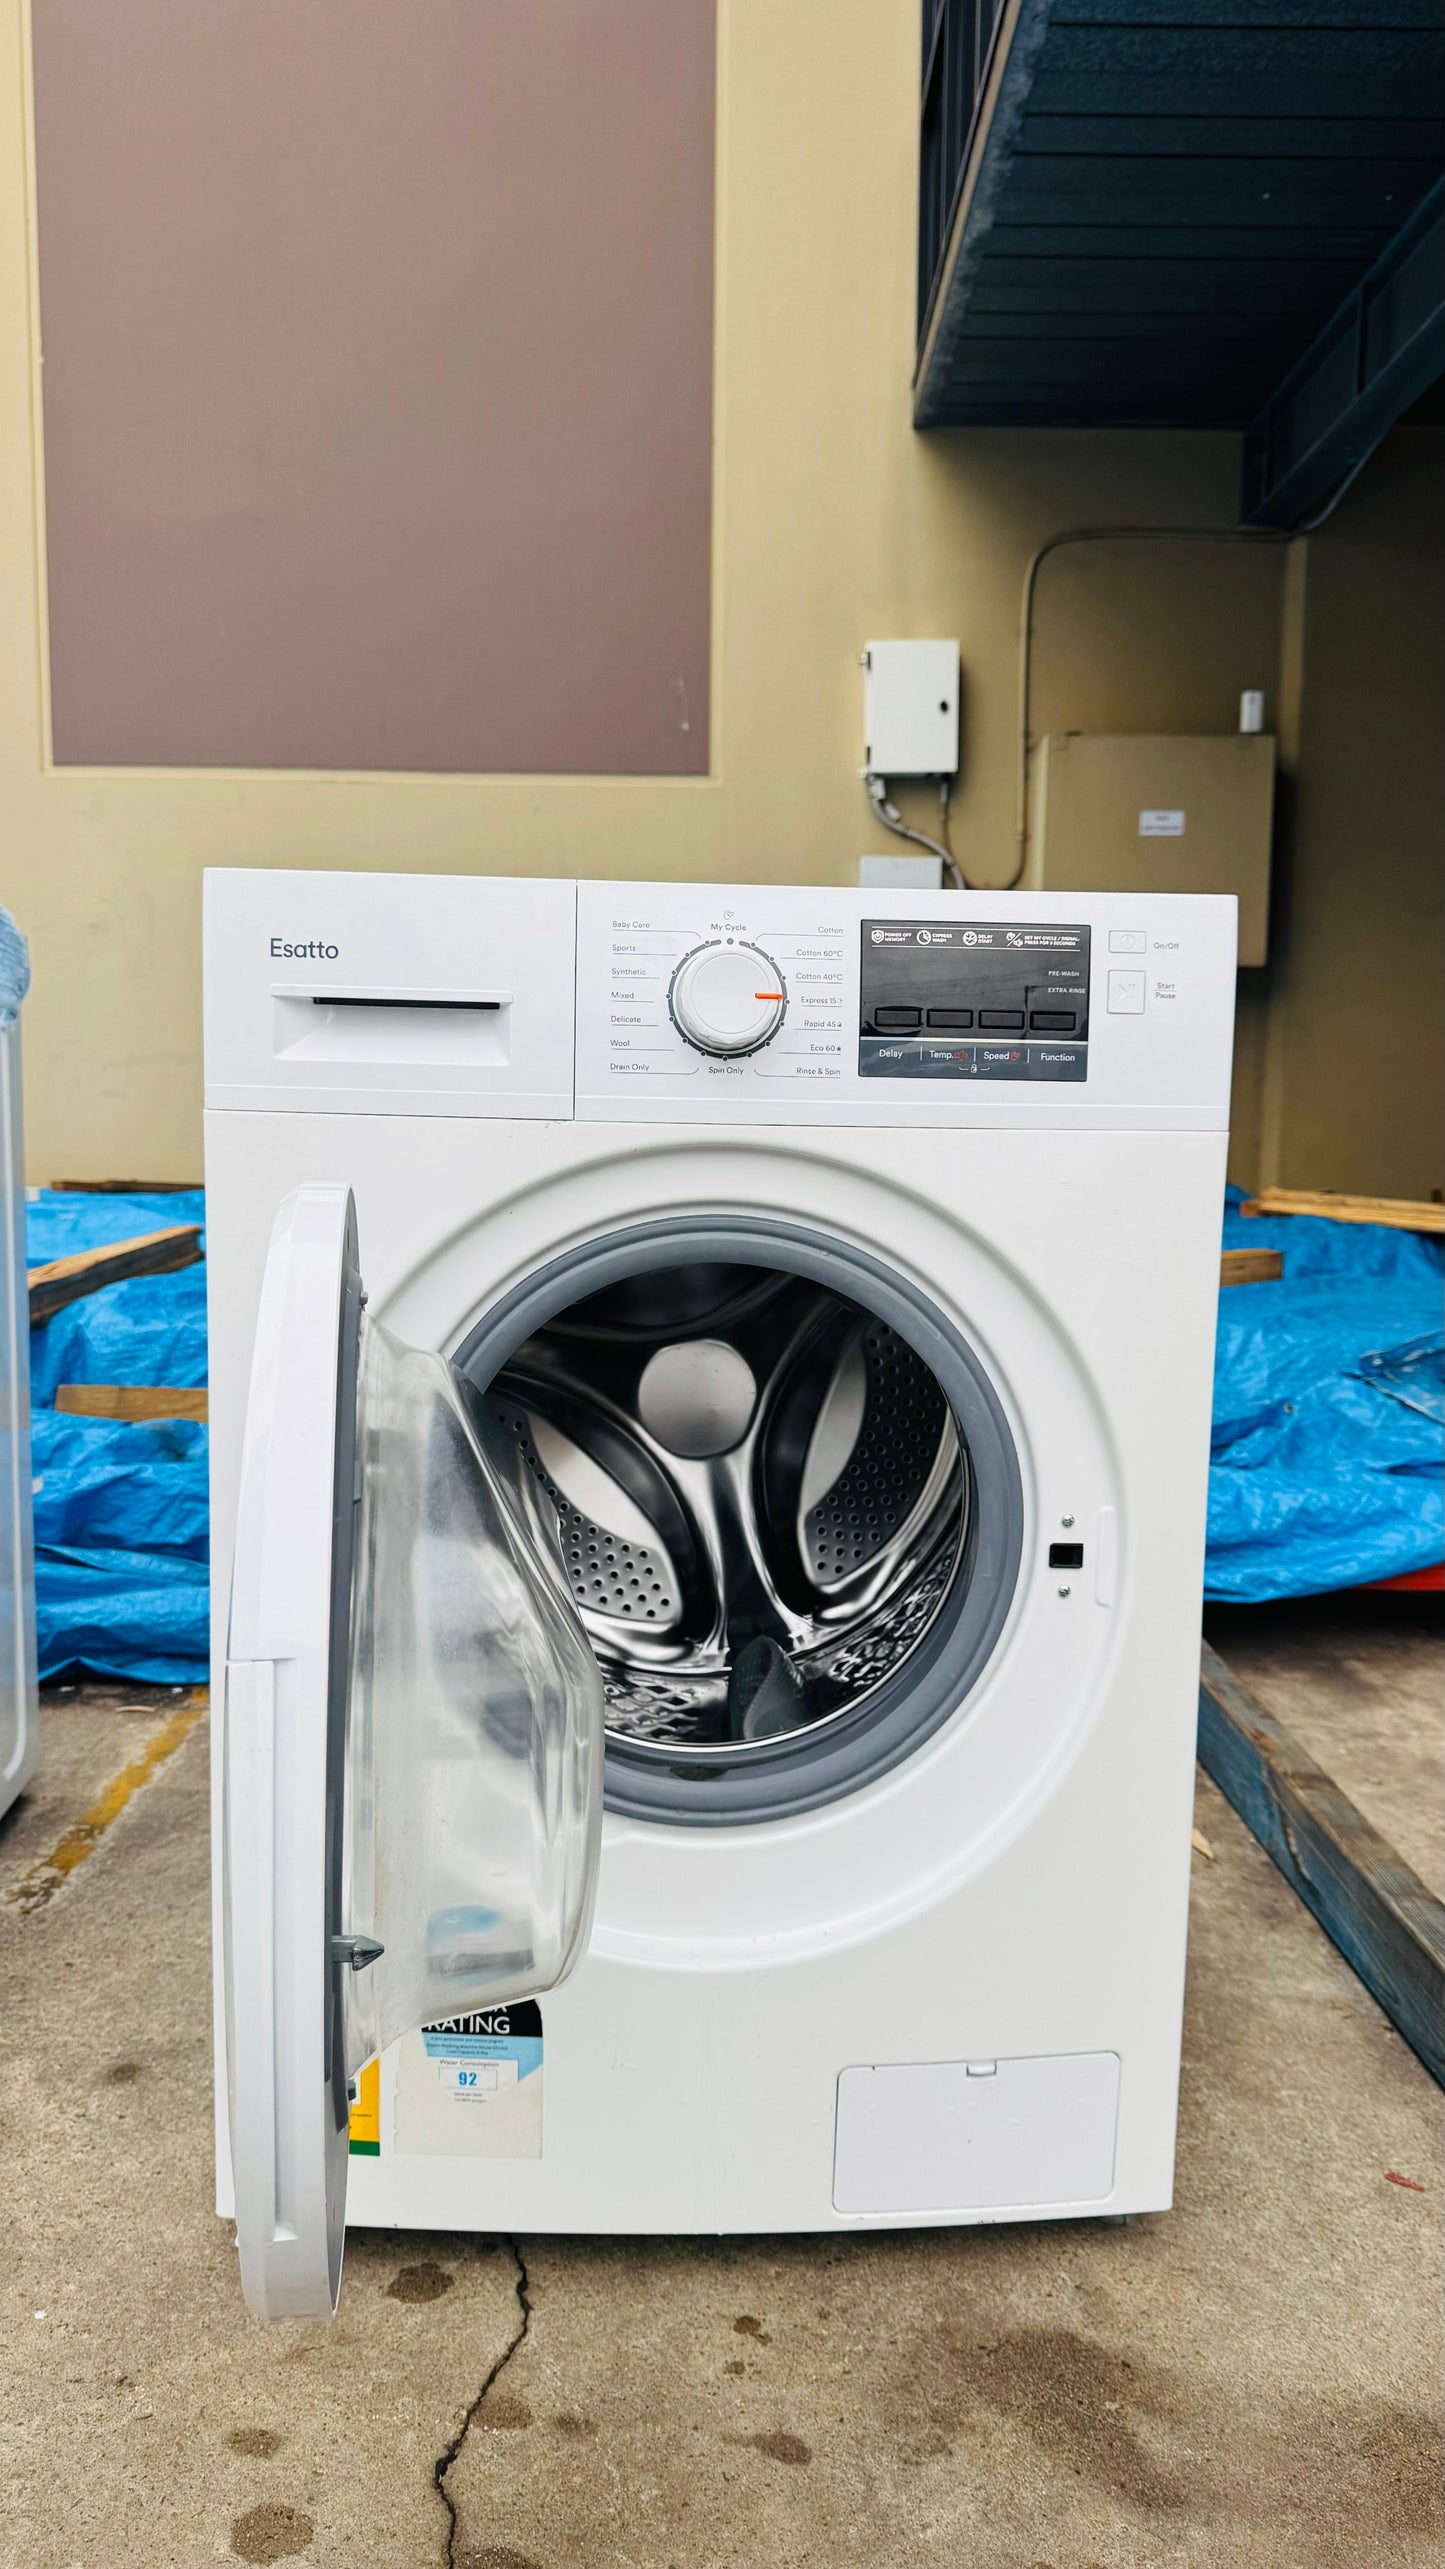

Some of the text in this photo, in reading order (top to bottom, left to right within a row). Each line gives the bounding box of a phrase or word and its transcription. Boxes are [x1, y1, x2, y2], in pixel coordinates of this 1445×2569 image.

[711, 923, 722, 931] My
[270, 937, 339, 959] Esatto
[612, 944, 636, 952] Sports
[1154, 942, 1179, 950] On/Off
[796, 949, 822, 957] Cotton
[611, 968, 646, 976] Synthetic
[823, 973, 843, 981] 40°C
[801, 996, 828, 1005] Express
[611, 1015, 641, 1023] Delicate
[804, 1020, 825, 1028] Rapid
[879, 1049, 903, 1059] Delay
[929, 1050, 954, 1060] Temp.
[984, 1051, 1010, 1061] Speed
[1041, 1052, 1075, 1062] Function
[632, 1064, 650, 1072] Only
[726, 1067, 744, 1075] Only
[796, 1067, 816, 1075] Rinse
[824, 1068, 840, 1076] Spin
[458, 2072, 477, 2086] 92
